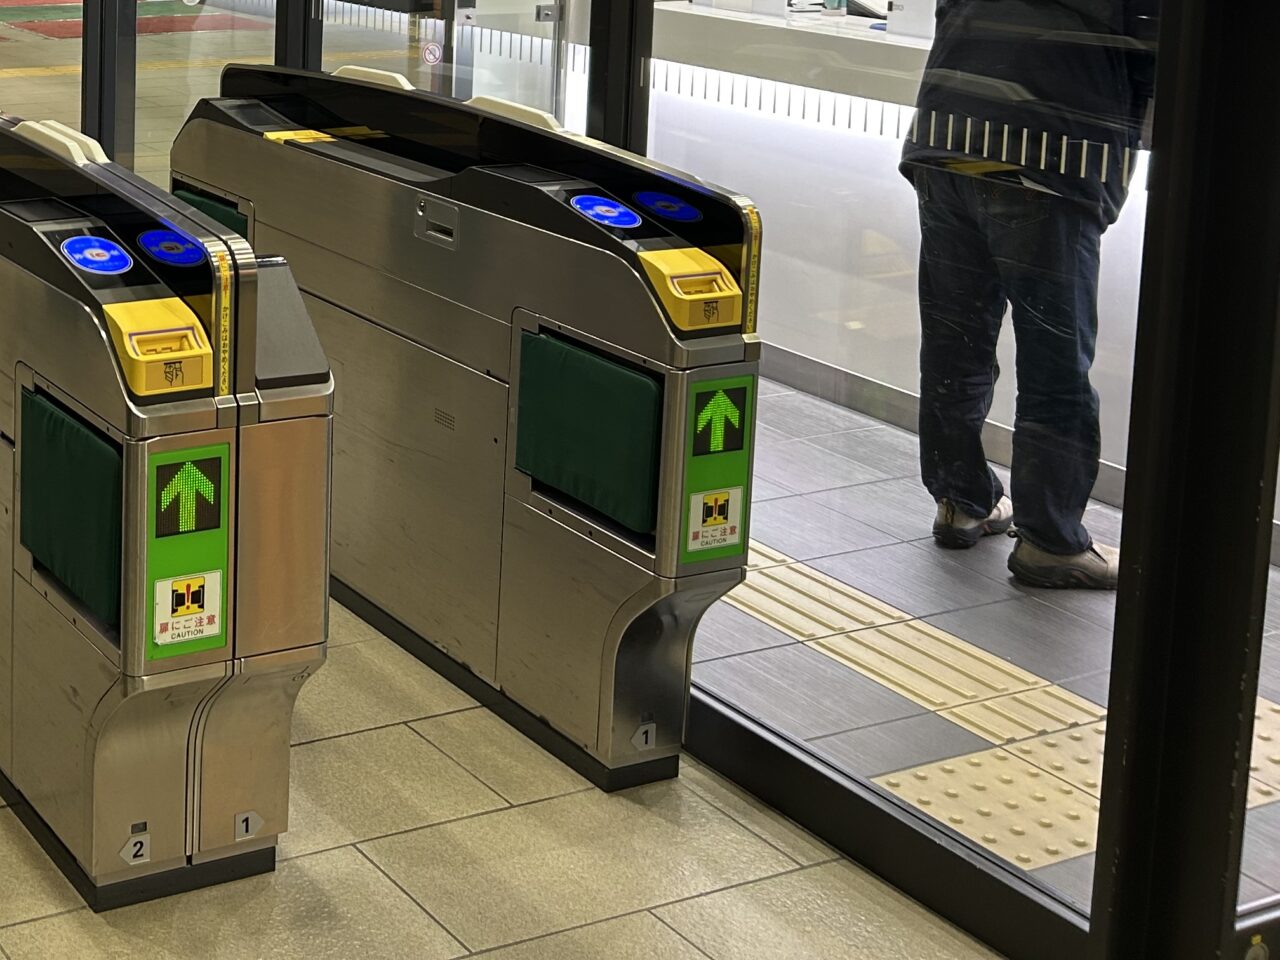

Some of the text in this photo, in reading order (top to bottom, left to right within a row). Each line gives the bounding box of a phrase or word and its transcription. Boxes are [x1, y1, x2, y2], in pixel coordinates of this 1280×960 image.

[700, 538, 727, 547] CAUTION
[159, 614, 217, 634] 扉にご注意
[171, 629, 204, 640] CAUTION
[641, 728, 651, 746] 1
[241, 816, 250, 834] 1
[132, 840, 145, 860] 2
